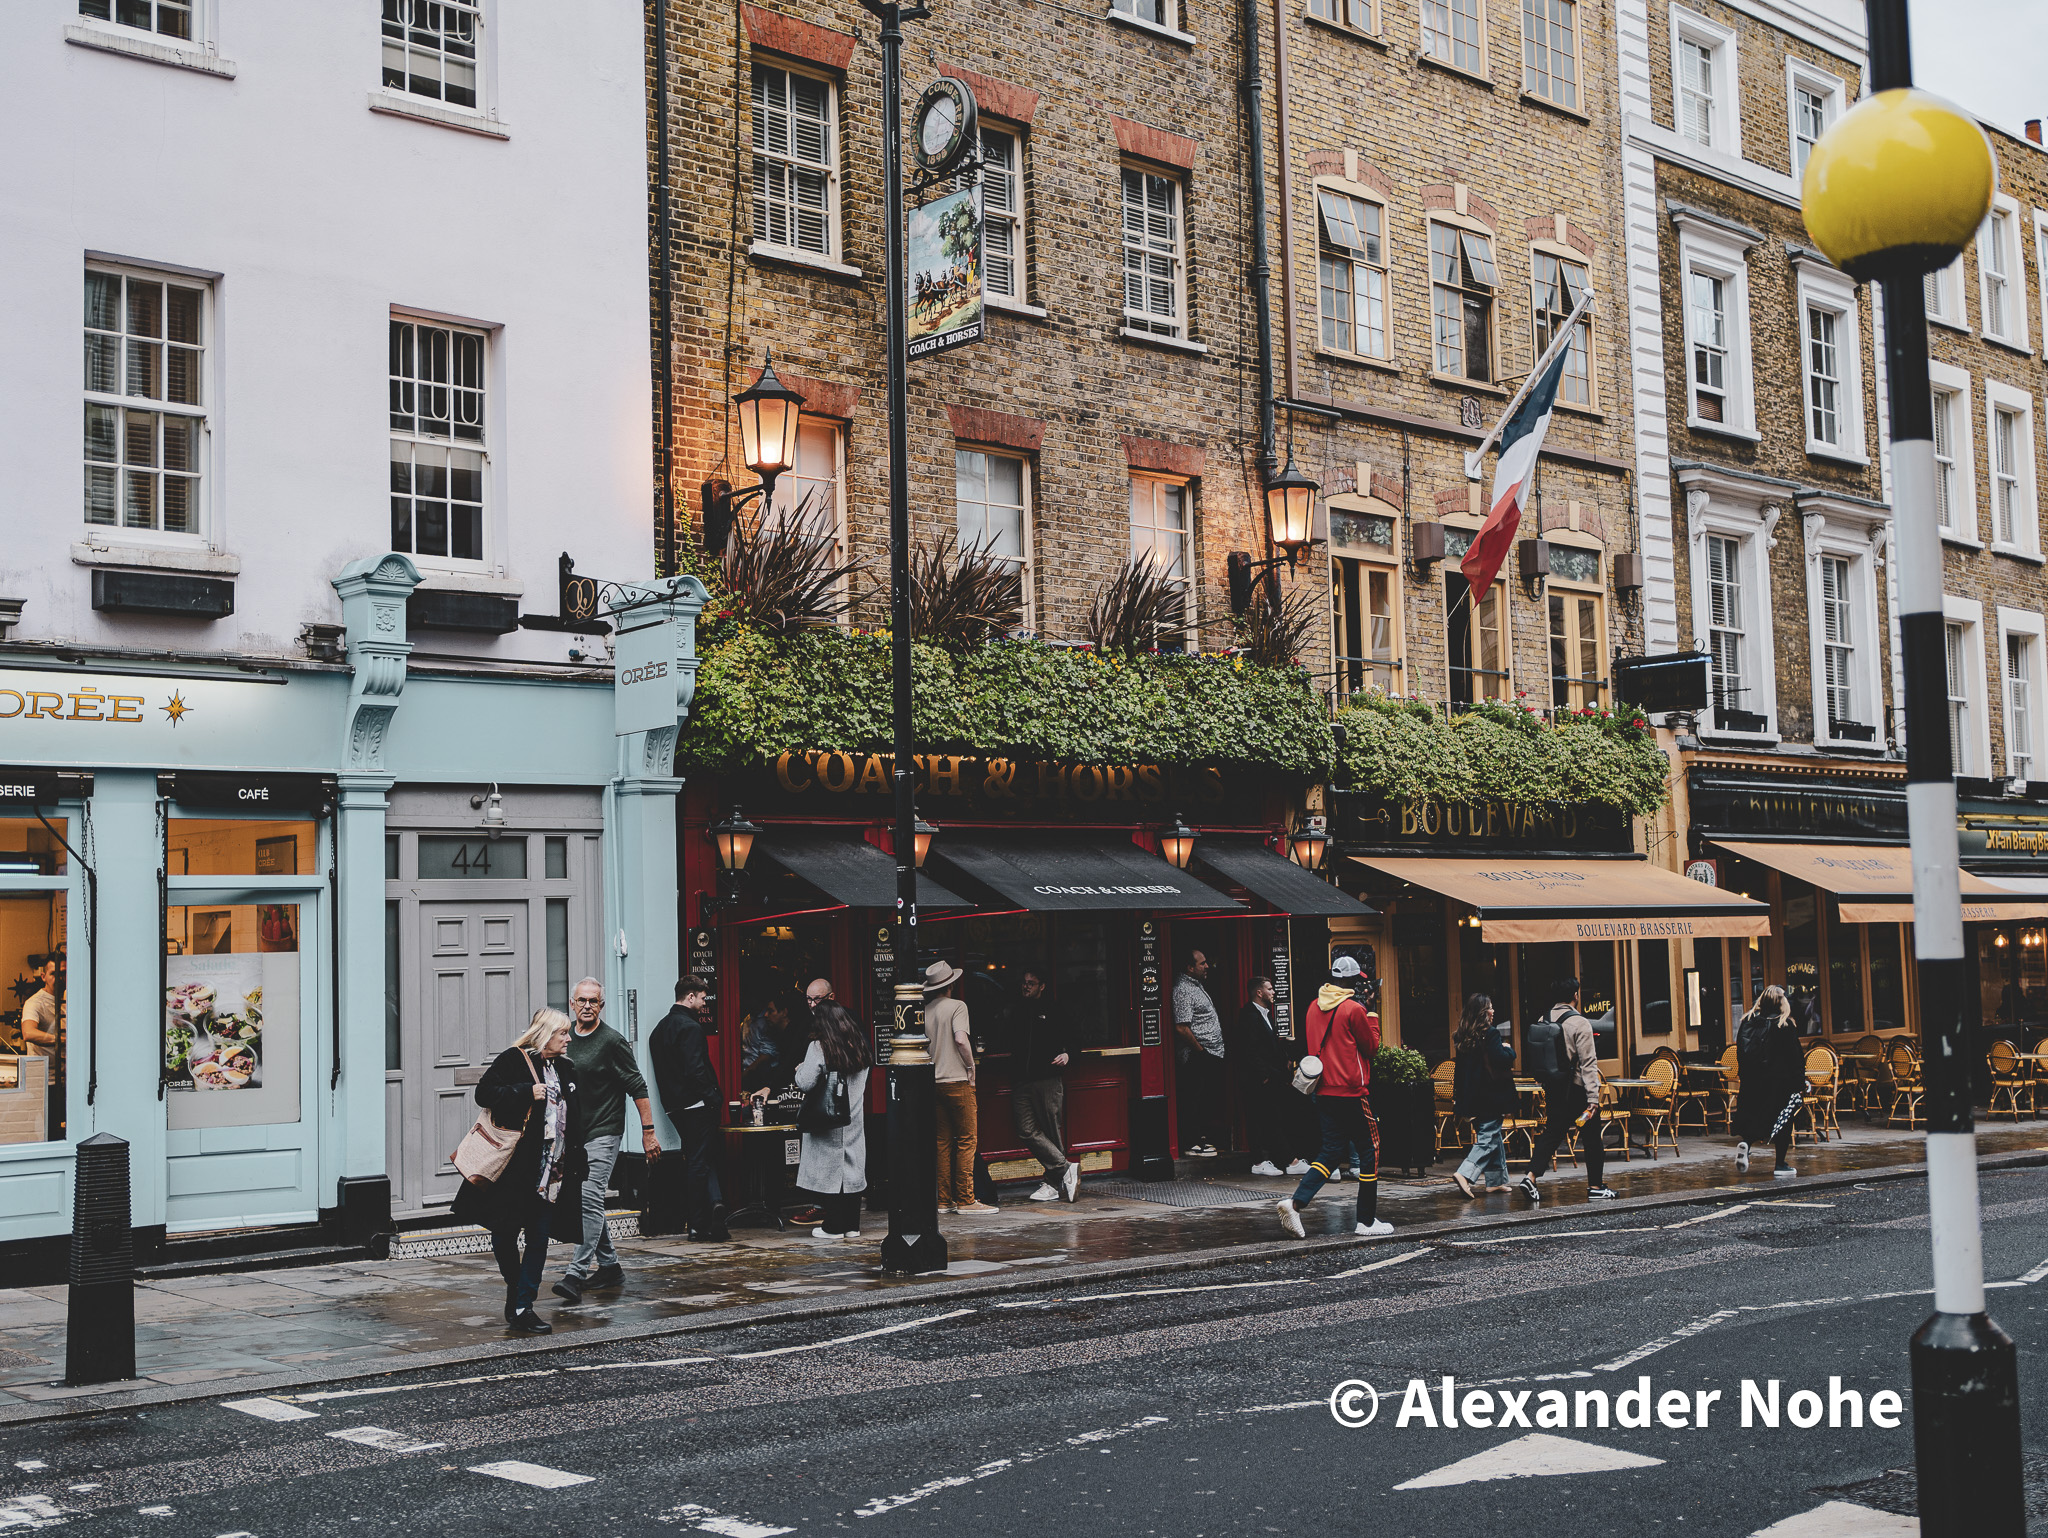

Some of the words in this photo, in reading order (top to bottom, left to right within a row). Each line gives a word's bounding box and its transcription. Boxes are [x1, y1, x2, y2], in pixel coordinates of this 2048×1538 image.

[928, 81, 959, 100] COMBE
[909, 338, 937, 356] COACH
[937, 336, 945, 348] &
[945, 326, 979, 346] HORSES
[621, 661, 668, 685] ORÉE
[983, 755, 1017, 800] &
[1036, 761, 1226, 803] HORSS
[238, 786, 270, 801] CAFÉ
[451, 843, 492, 875] 44
[1034, 885, 1101, 895] COACH
[1098, 885, 1117, 895] &
[1113, 884, 1182, 895] HORSES
[1576, 923, 1636, 937] BOULEVARD
[1640, 922, 1694, 936] BRASSERIE
[692, 951, 713, 959] COACH
[692, 965, 715, 974] HORSES
